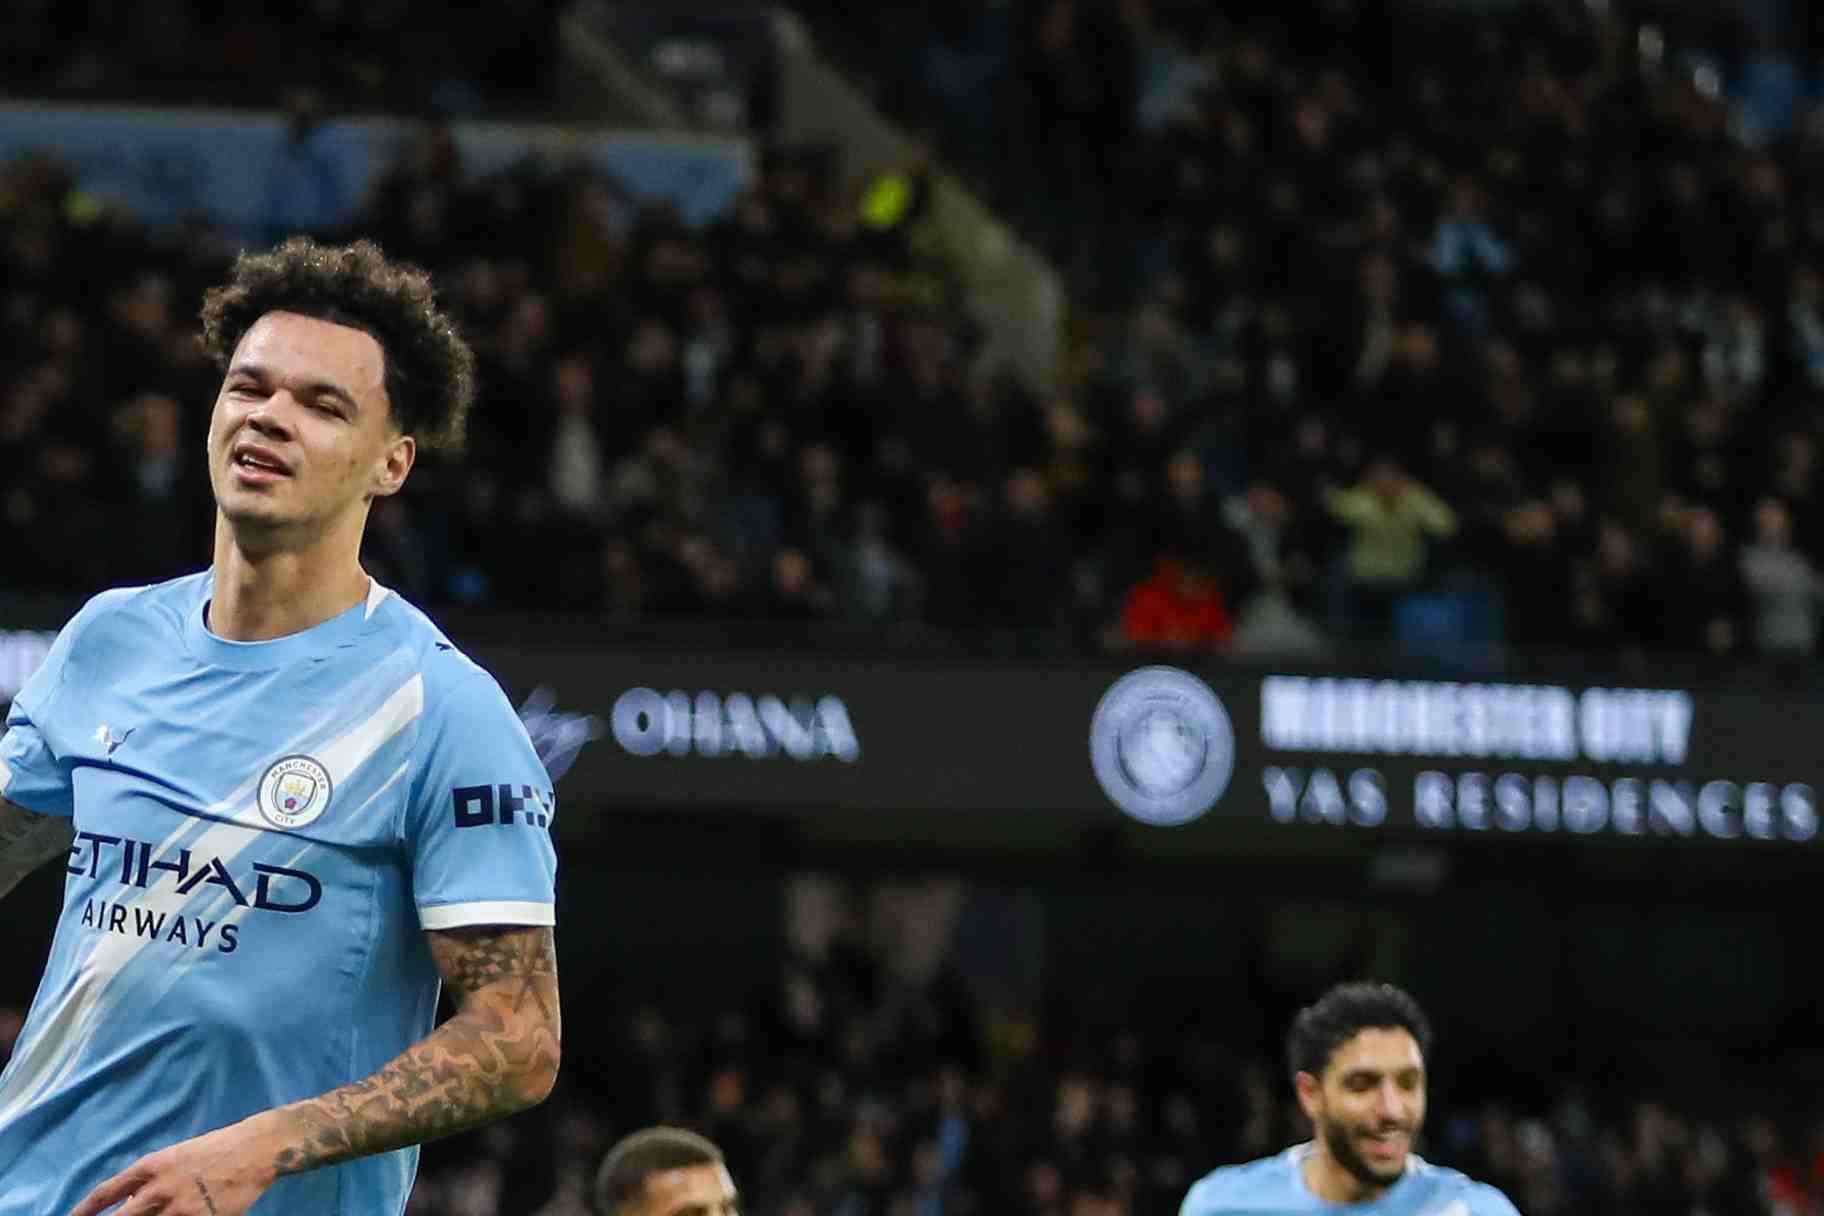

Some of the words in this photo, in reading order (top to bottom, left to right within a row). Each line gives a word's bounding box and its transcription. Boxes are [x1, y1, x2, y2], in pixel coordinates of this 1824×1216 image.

[612, 686, 859, 762] OHANA
[1263, 766, 1389, 827] YAS
[81, 897, 240, 953] AIRWAYS
